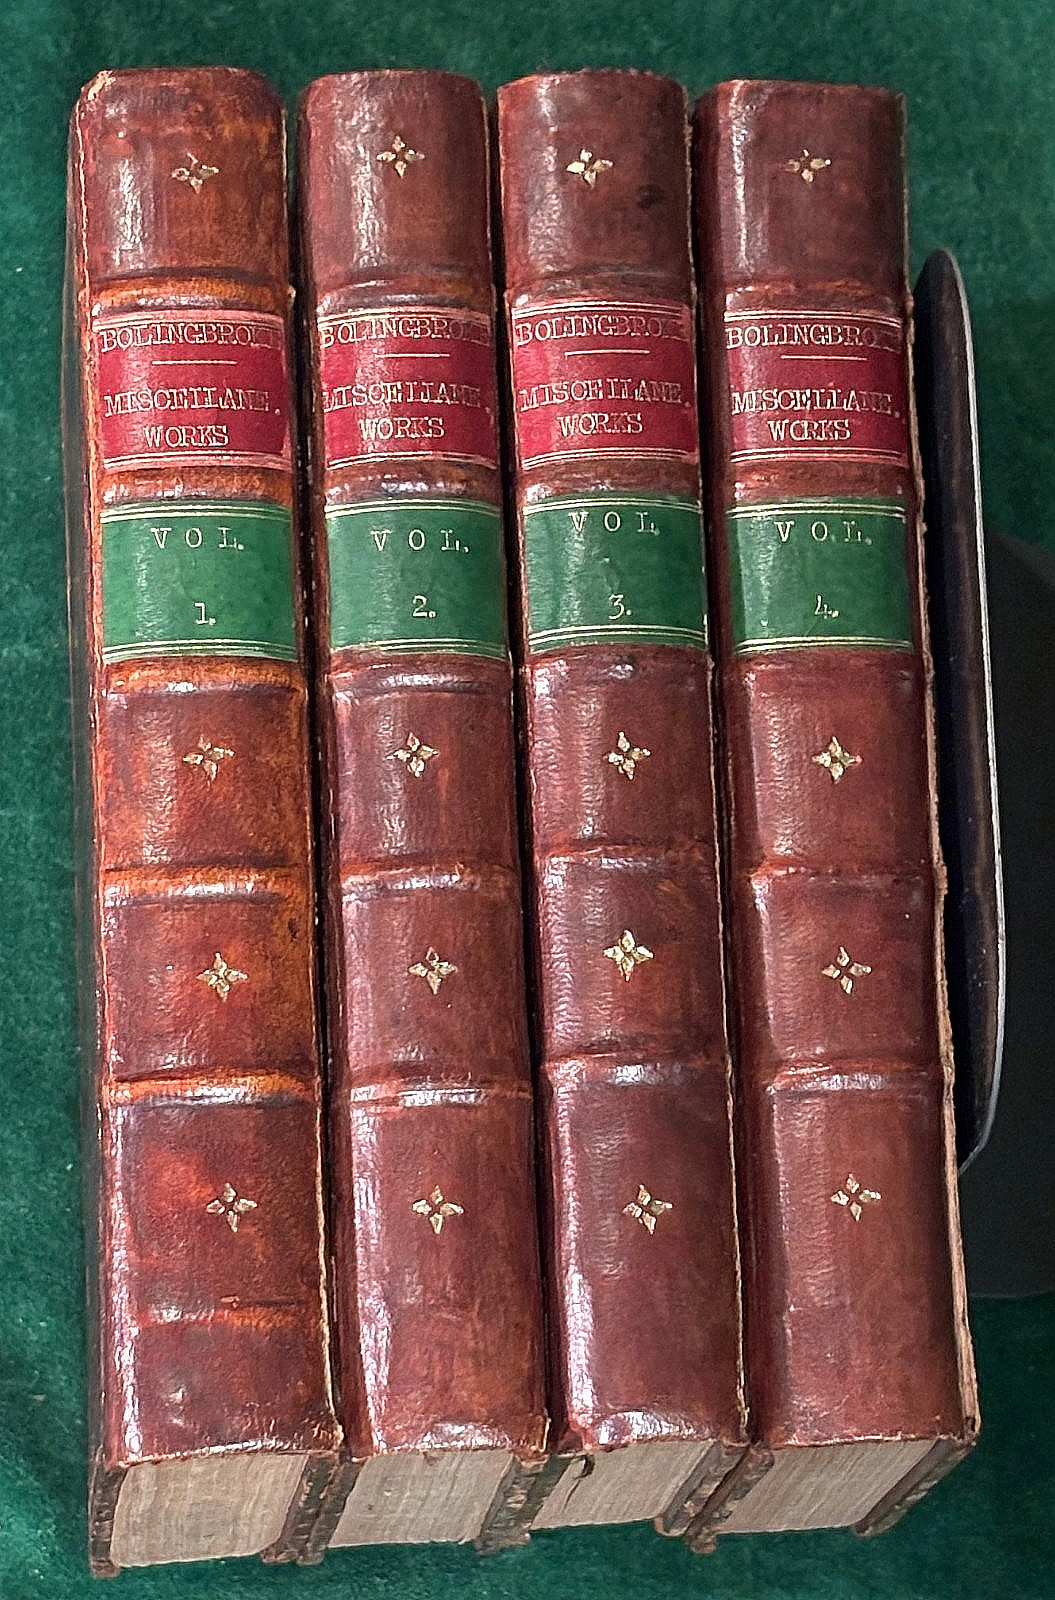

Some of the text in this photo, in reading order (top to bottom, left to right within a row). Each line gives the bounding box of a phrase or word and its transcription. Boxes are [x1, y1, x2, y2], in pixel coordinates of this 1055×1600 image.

[143, 424, 229, 447] WORKS
[358, 417, 445, 441] WORKS
[556, 412, 643, 437] WORKS
[767, 419, 851, 441] WORKS
[194, 602, 217, 625] 1.
[412, 595, 436, 618] 2.
[608, 594, 632, 620] 3.
[814, 595, 839, 619] 4.
